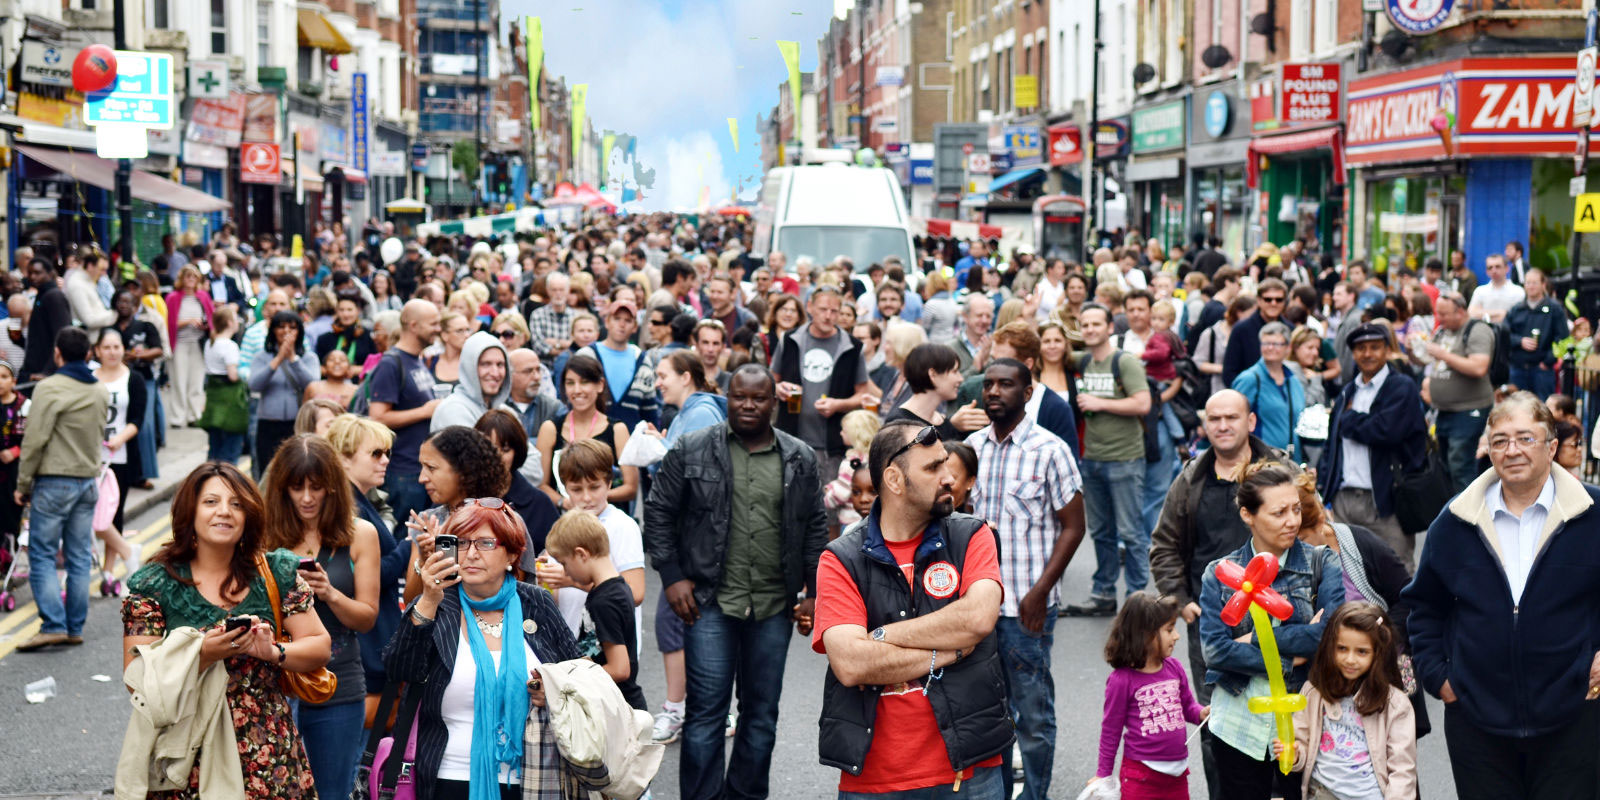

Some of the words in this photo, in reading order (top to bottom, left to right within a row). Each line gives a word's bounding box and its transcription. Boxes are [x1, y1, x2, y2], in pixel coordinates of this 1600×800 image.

[1391, 5, 1449, 31] CHICKEN
[1300, 66, 1324, 78] SM
[1284, 79, 1338, 92] POUND
[1290, 93, 1331, 106] PLUS
[1289, 107, 1332, 120] SHOP
[1347, 99, 1383, 142] ZAM'S
[1383, 90, 1438, 138] CHICKEN
[1580, 203, 1596, 223] A
